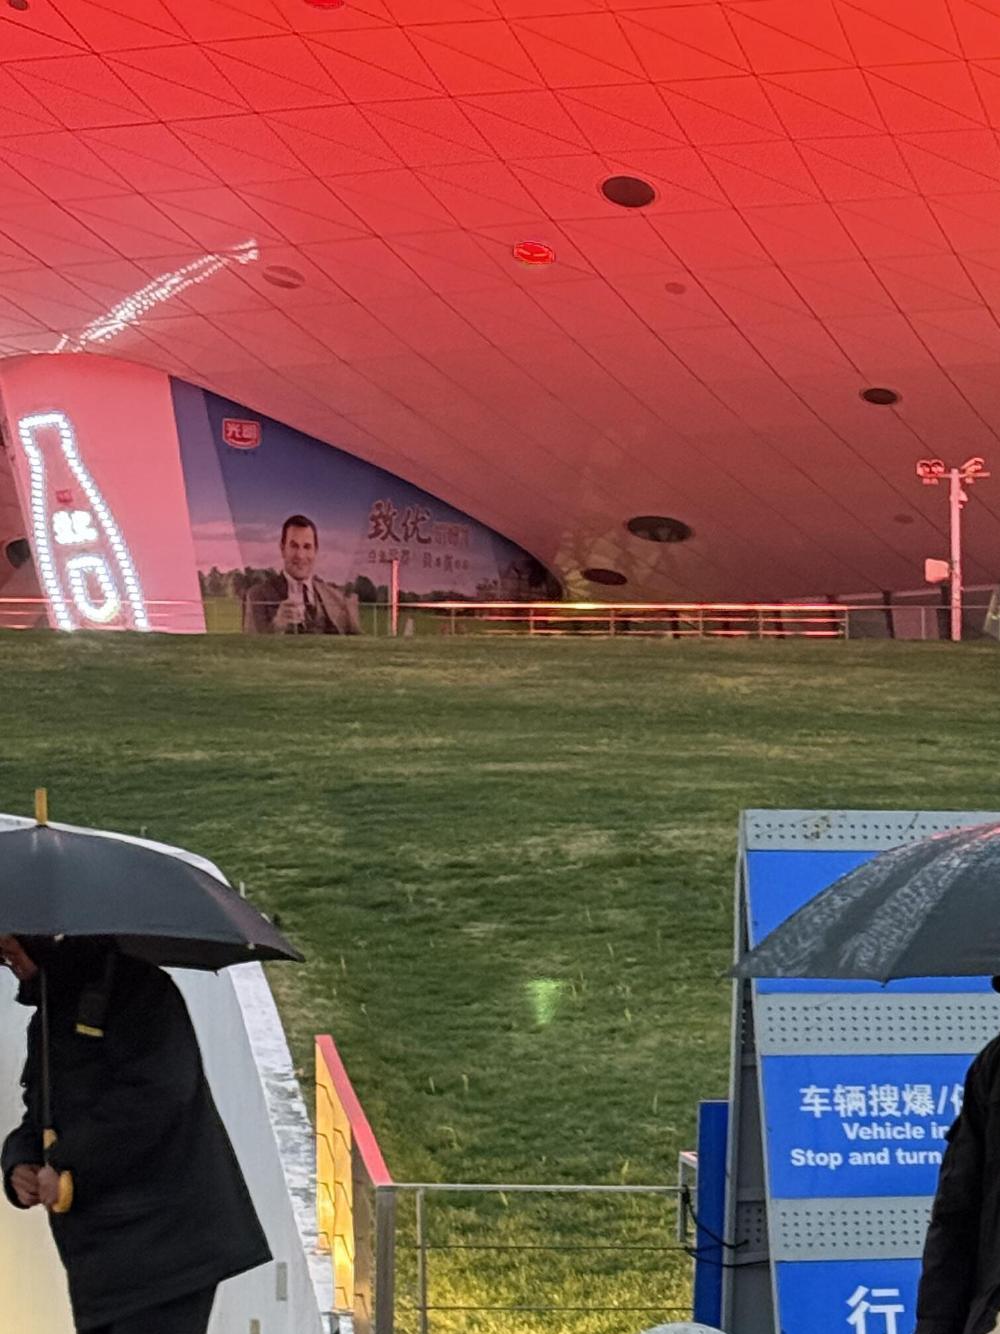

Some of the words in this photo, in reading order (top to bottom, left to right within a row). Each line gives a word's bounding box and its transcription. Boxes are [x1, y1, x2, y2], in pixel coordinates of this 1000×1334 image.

[842, 1121, 925, 1140] Vehicle
[790, 1148, 843, 1170] Stop
[848, 1147, 890, 1166] and
[895, 1147, 942, 1165] turn
